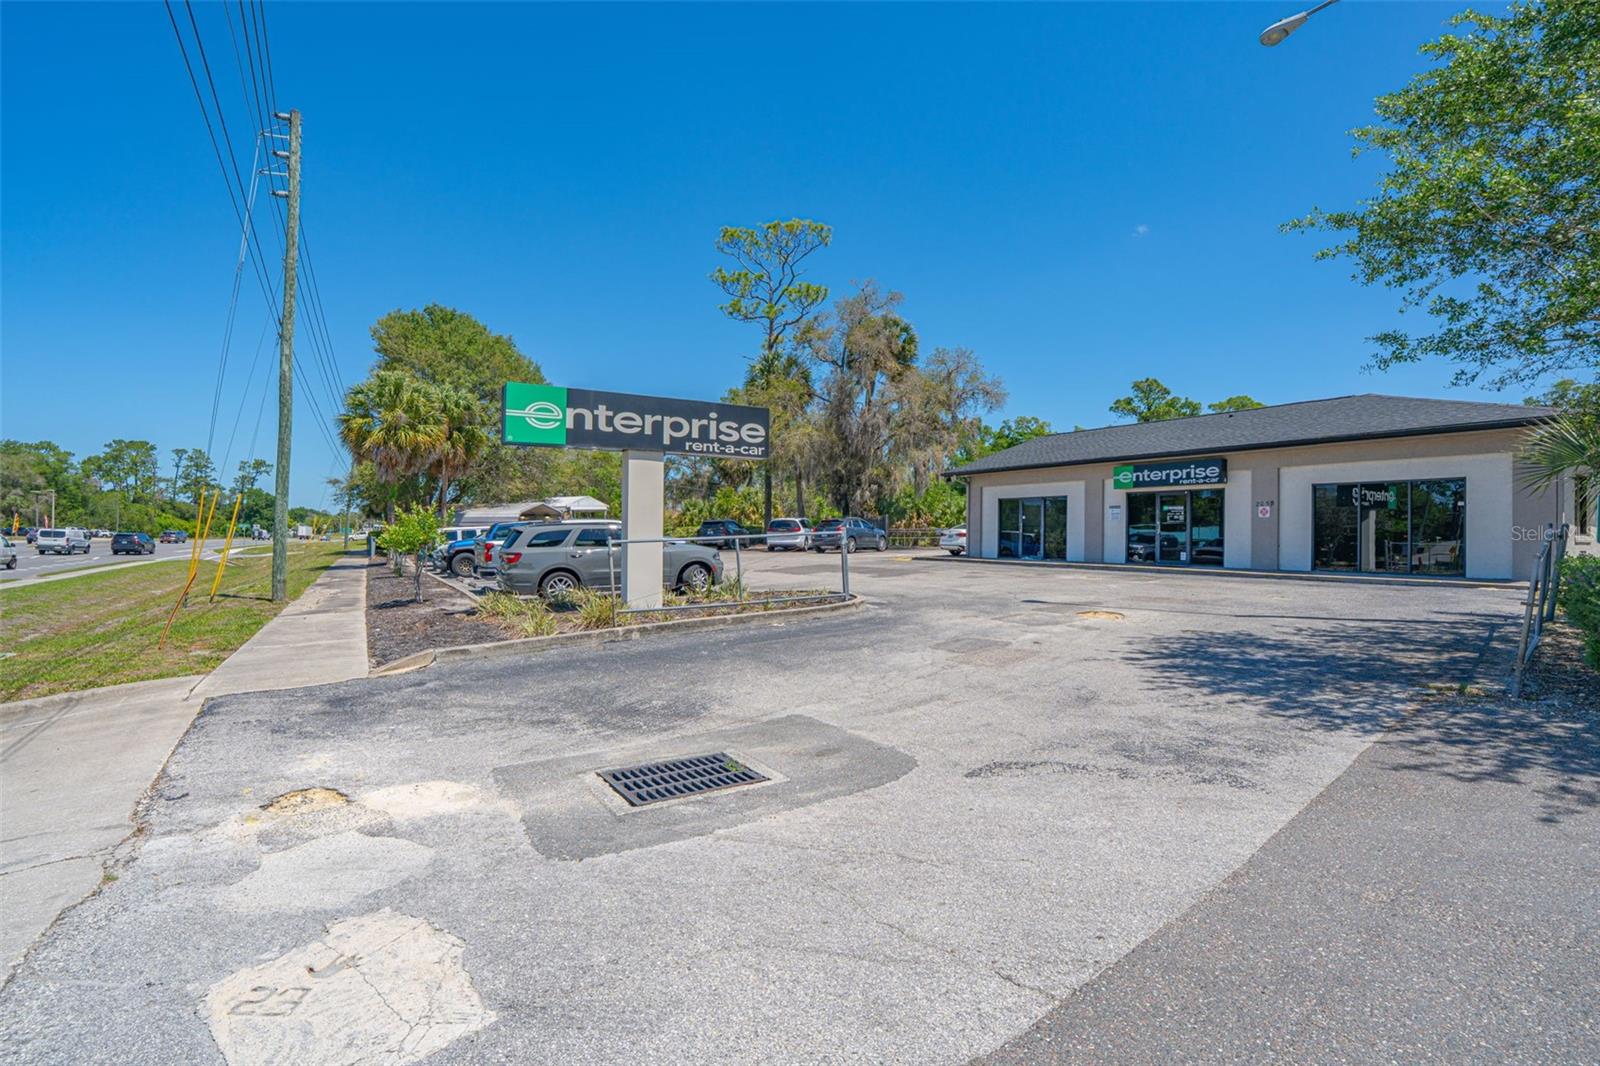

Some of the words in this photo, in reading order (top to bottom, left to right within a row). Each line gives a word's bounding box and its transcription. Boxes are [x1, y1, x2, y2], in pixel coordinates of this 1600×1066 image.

[506, 401, 766, 445] enterprise
[685, 440, 765, 456] rent-a-car
[1114, 464, 1220, 483] enterprise
[1179, 477, 1220, 485] rent-a-car
